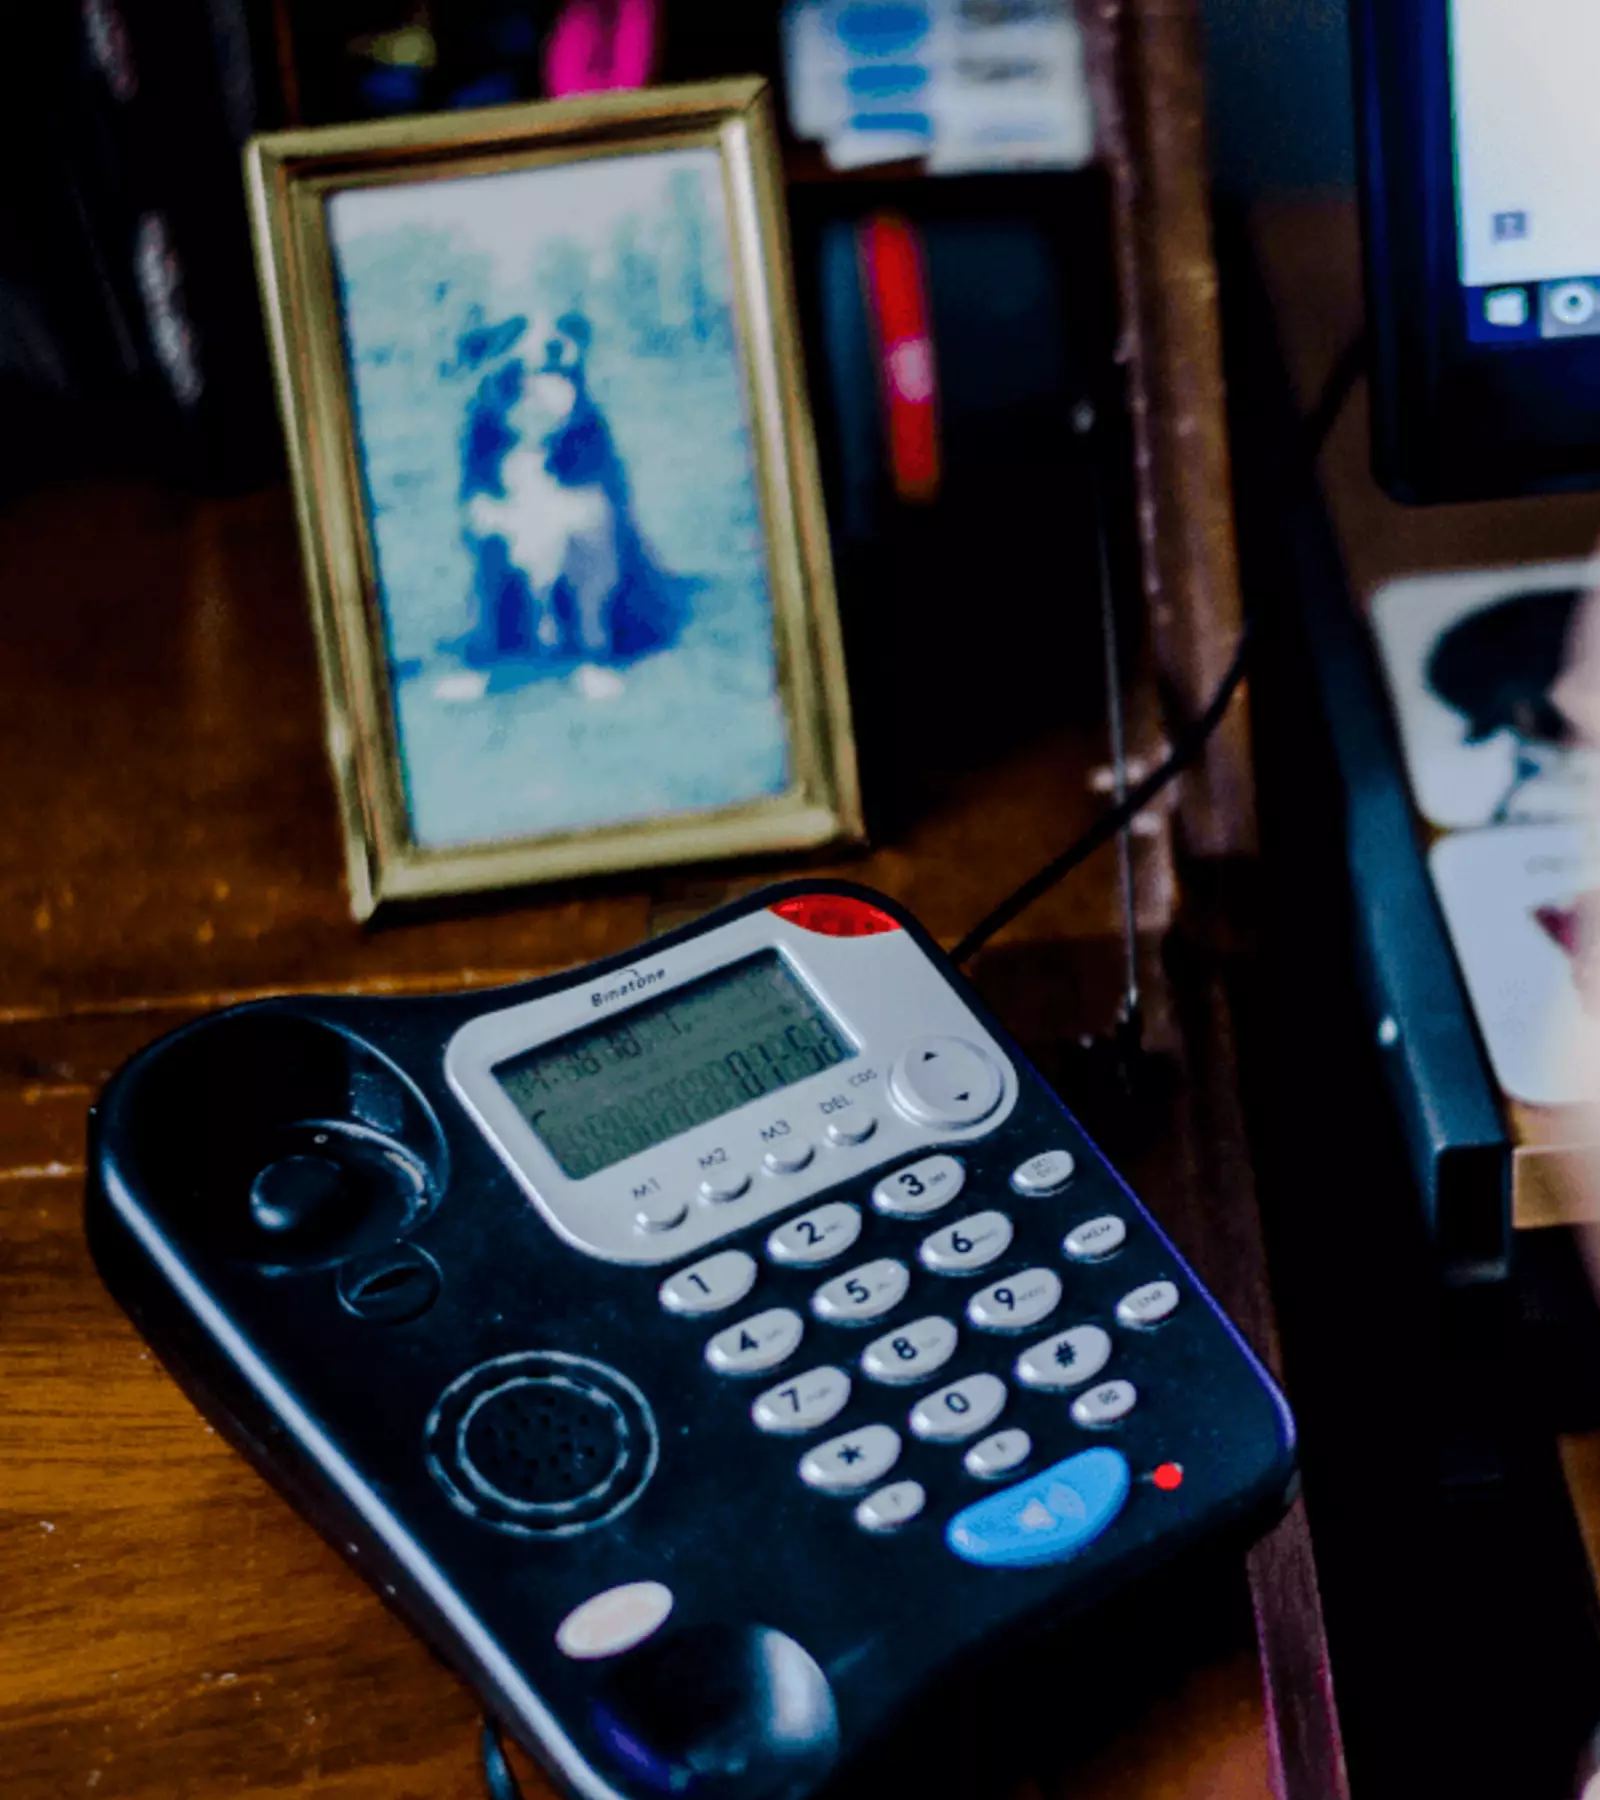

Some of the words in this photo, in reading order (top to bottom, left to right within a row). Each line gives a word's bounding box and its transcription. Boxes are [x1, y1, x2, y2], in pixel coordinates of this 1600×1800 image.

[591, 967, 665, 1008] Binatone
[820, 1094, 855, 1115] DEL
[760, 1118, 791, 1142] M3
[699, 1147, 730, 1171] M2
[632, 1176, 661, 1200] M1
[898, 1173, 925, 1197] 3
[796, 1221, 825, 1246] 2
[951, 1231, 974, 1254] 6
[687, 1271, 711, 1296] 1
[844, 1278, 871, 1304] 5
[993, 1287, 1015, 1312] 9
[739, 1329, 759, 1352] 4
[892, 1337, 918, 1361] 8
[1054, 1340, 1077, 1368] #
[779, 1386, 800, 1413] 7
[944, 1392, 970, 1414] 0
